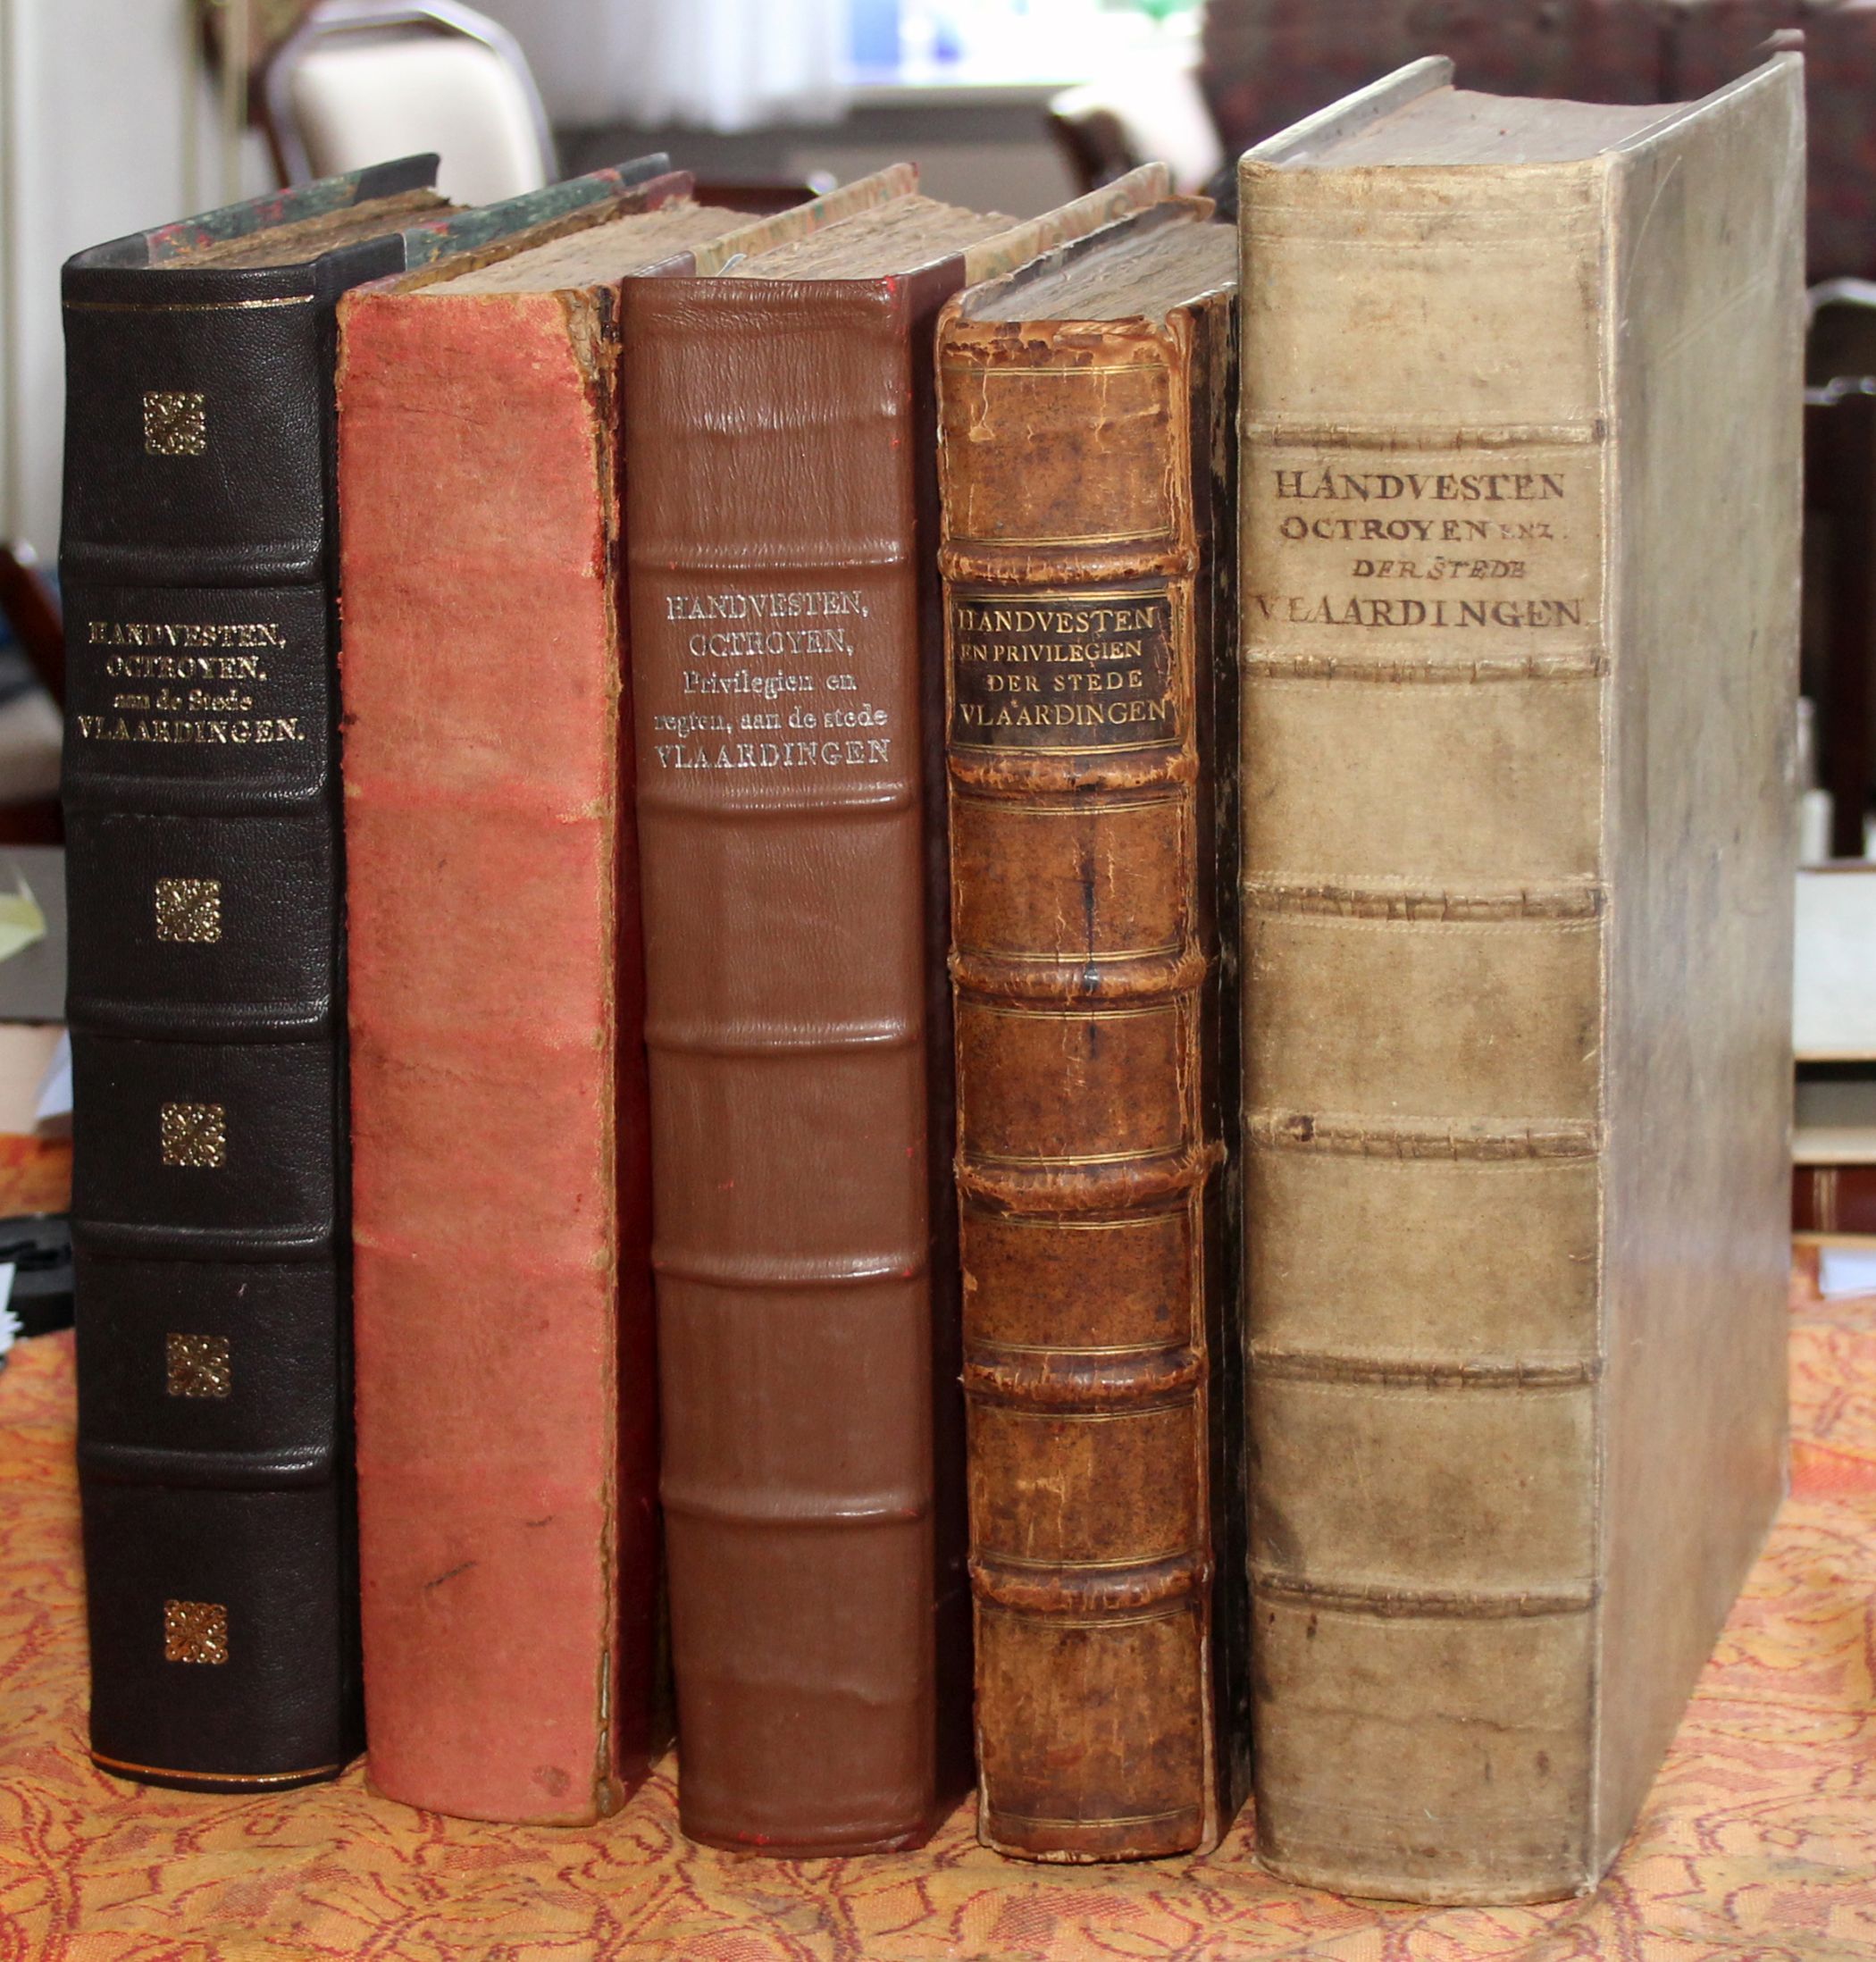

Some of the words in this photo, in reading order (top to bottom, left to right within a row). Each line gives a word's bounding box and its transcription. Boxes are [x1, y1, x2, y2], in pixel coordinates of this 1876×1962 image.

[1275, 466, 1565, 501] HANDVESTEN
[1279, 516, 1487, 541] OCTROYEN
[666, 591, 869, 620] HANDVESTEN,
[1252, 595, 1584, 627] VLAARDINGEN
[959, 607, 1159, 633] HANDVESTEN
[689, 628, 854, 658] OCTROYEN,
[993, 641, 1143, 662] PRIVILEGIEN
[683, 669, 815, 700] Privilegien
[825, 674, 858, 691] en
[987, 675, 1041, 692] DER
[1053, 670, 1143, 692] STEDE
[155, 688, 183, 710] de
[188, 688, 254, 710] Stede
[740, 712, 782, 729] aan
[788, 705, 817, 728] de
[823, 703, 888, 727] stede
[960, 700, 1168, 726] VLAARDINGEN
[654, 739, 892, 768] VLAARDINGEN
